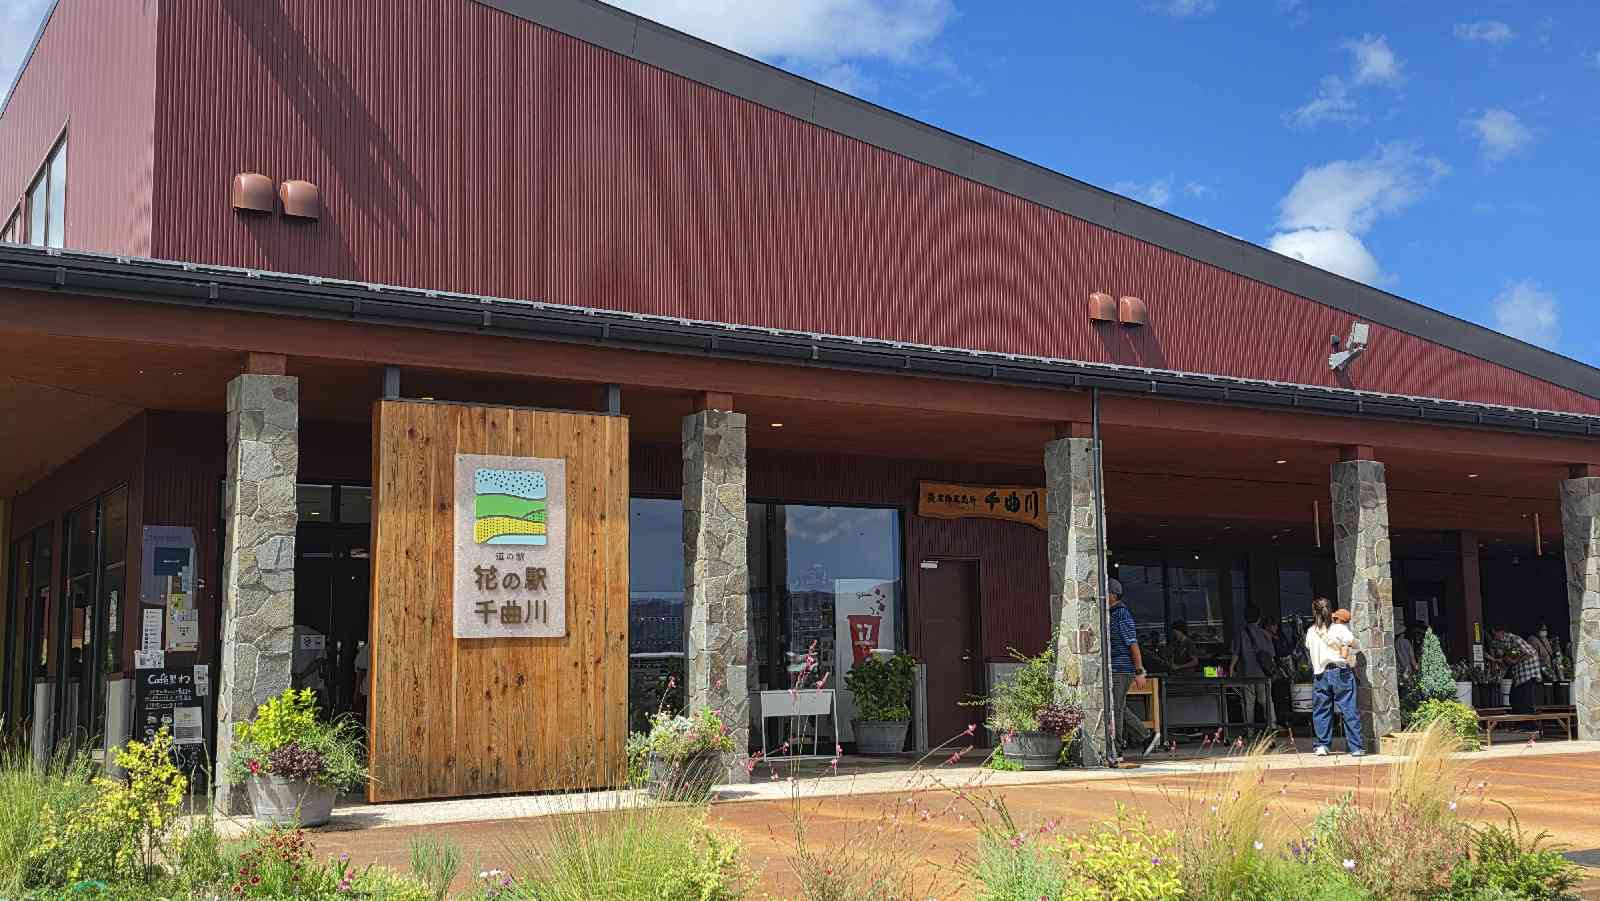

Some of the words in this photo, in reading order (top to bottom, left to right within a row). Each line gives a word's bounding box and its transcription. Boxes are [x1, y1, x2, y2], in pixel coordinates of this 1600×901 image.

[985, 490, 1039, 518] 千曲川
[474, 565, 547, 591] 花の駅
[474, 600, 547, 624] 千曲川
